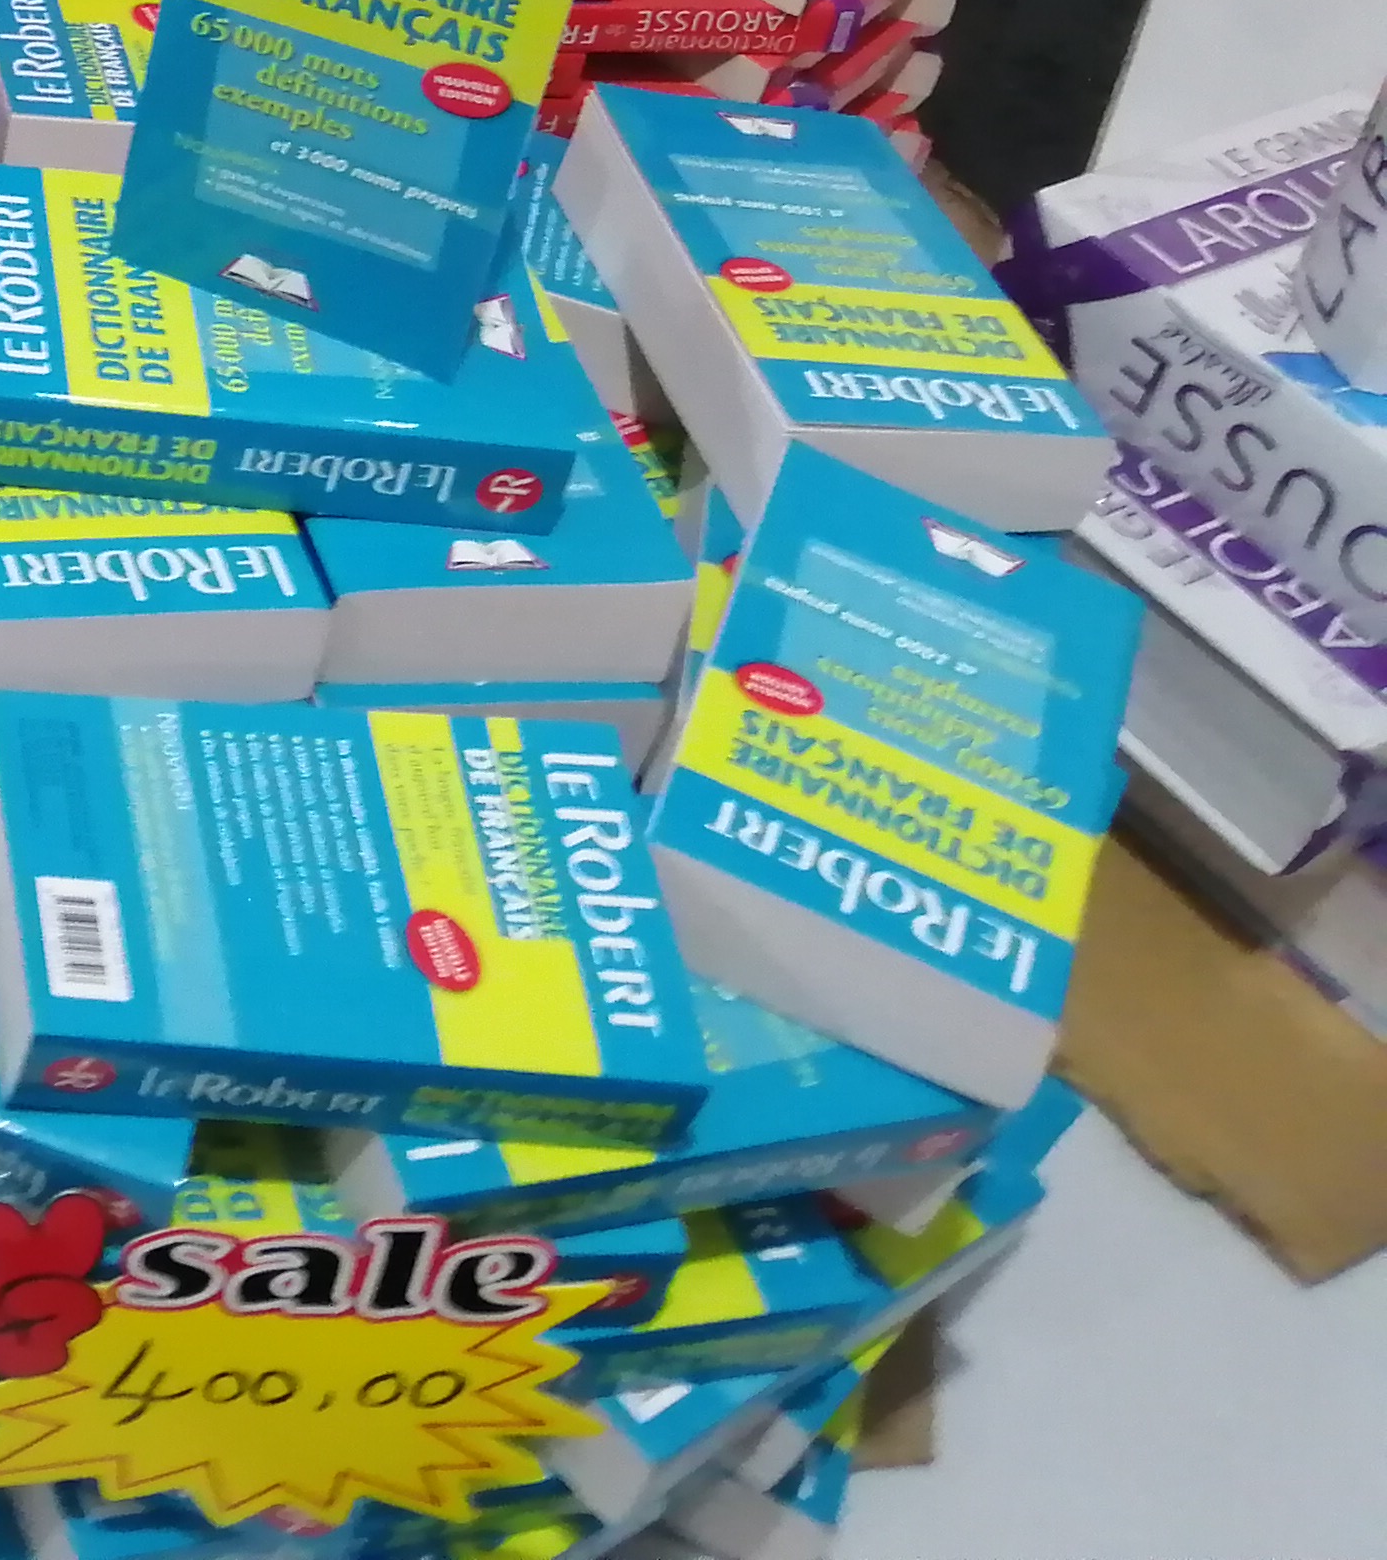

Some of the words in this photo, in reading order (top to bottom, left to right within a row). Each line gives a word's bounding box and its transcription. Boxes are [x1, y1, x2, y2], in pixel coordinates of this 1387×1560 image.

[255, 64, 428, 135] définitions
[301, 50, 381, 89] mots
[213, 82, 355, 140] exemples
[351, 166, 402, 192] noms
[403, 184, 478, 221] propres
[70, 196, 129, 382] DICTIONNAIRE
[741, 710, 978, 833] FRANÇAIS
[728, 740, 1048, 901] DICTIONNAIRE
[991, 822, 1055, 866] DE
[118, 1227, 552, 1321] sale
[102, 1341, 466, 1427] 400,00
